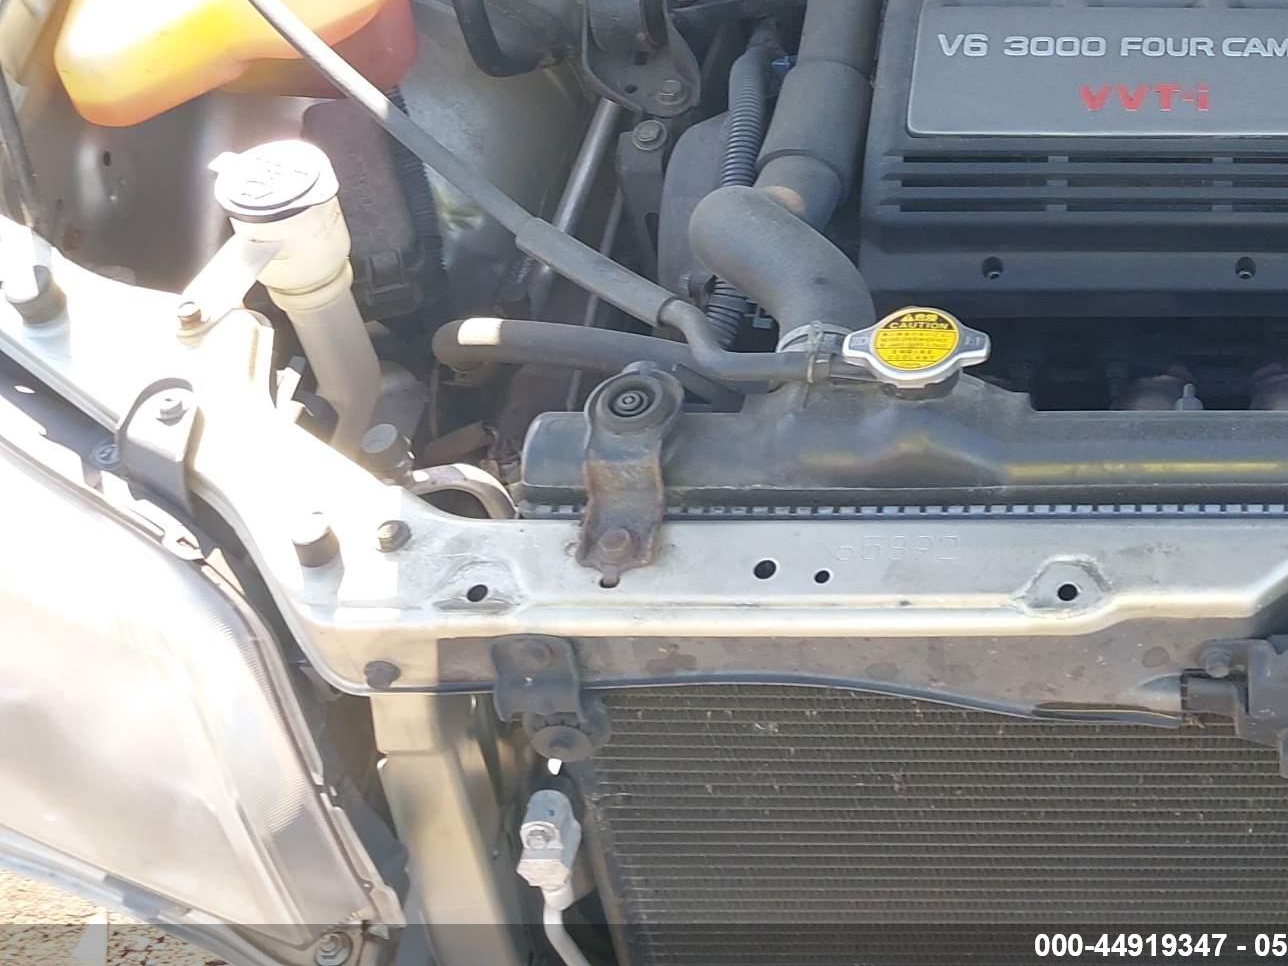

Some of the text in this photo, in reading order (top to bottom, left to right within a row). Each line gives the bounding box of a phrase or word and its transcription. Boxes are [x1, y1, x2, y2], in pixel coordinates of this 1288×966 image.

[937, 34, 988, 57] V6
[1003, 35, 1106, 57] 3000
[1120, 36, 1215, 57] FOUR
[1078, 83, 1209, 112] VVT-i
[889, 321, 949, 330] CAUTION
